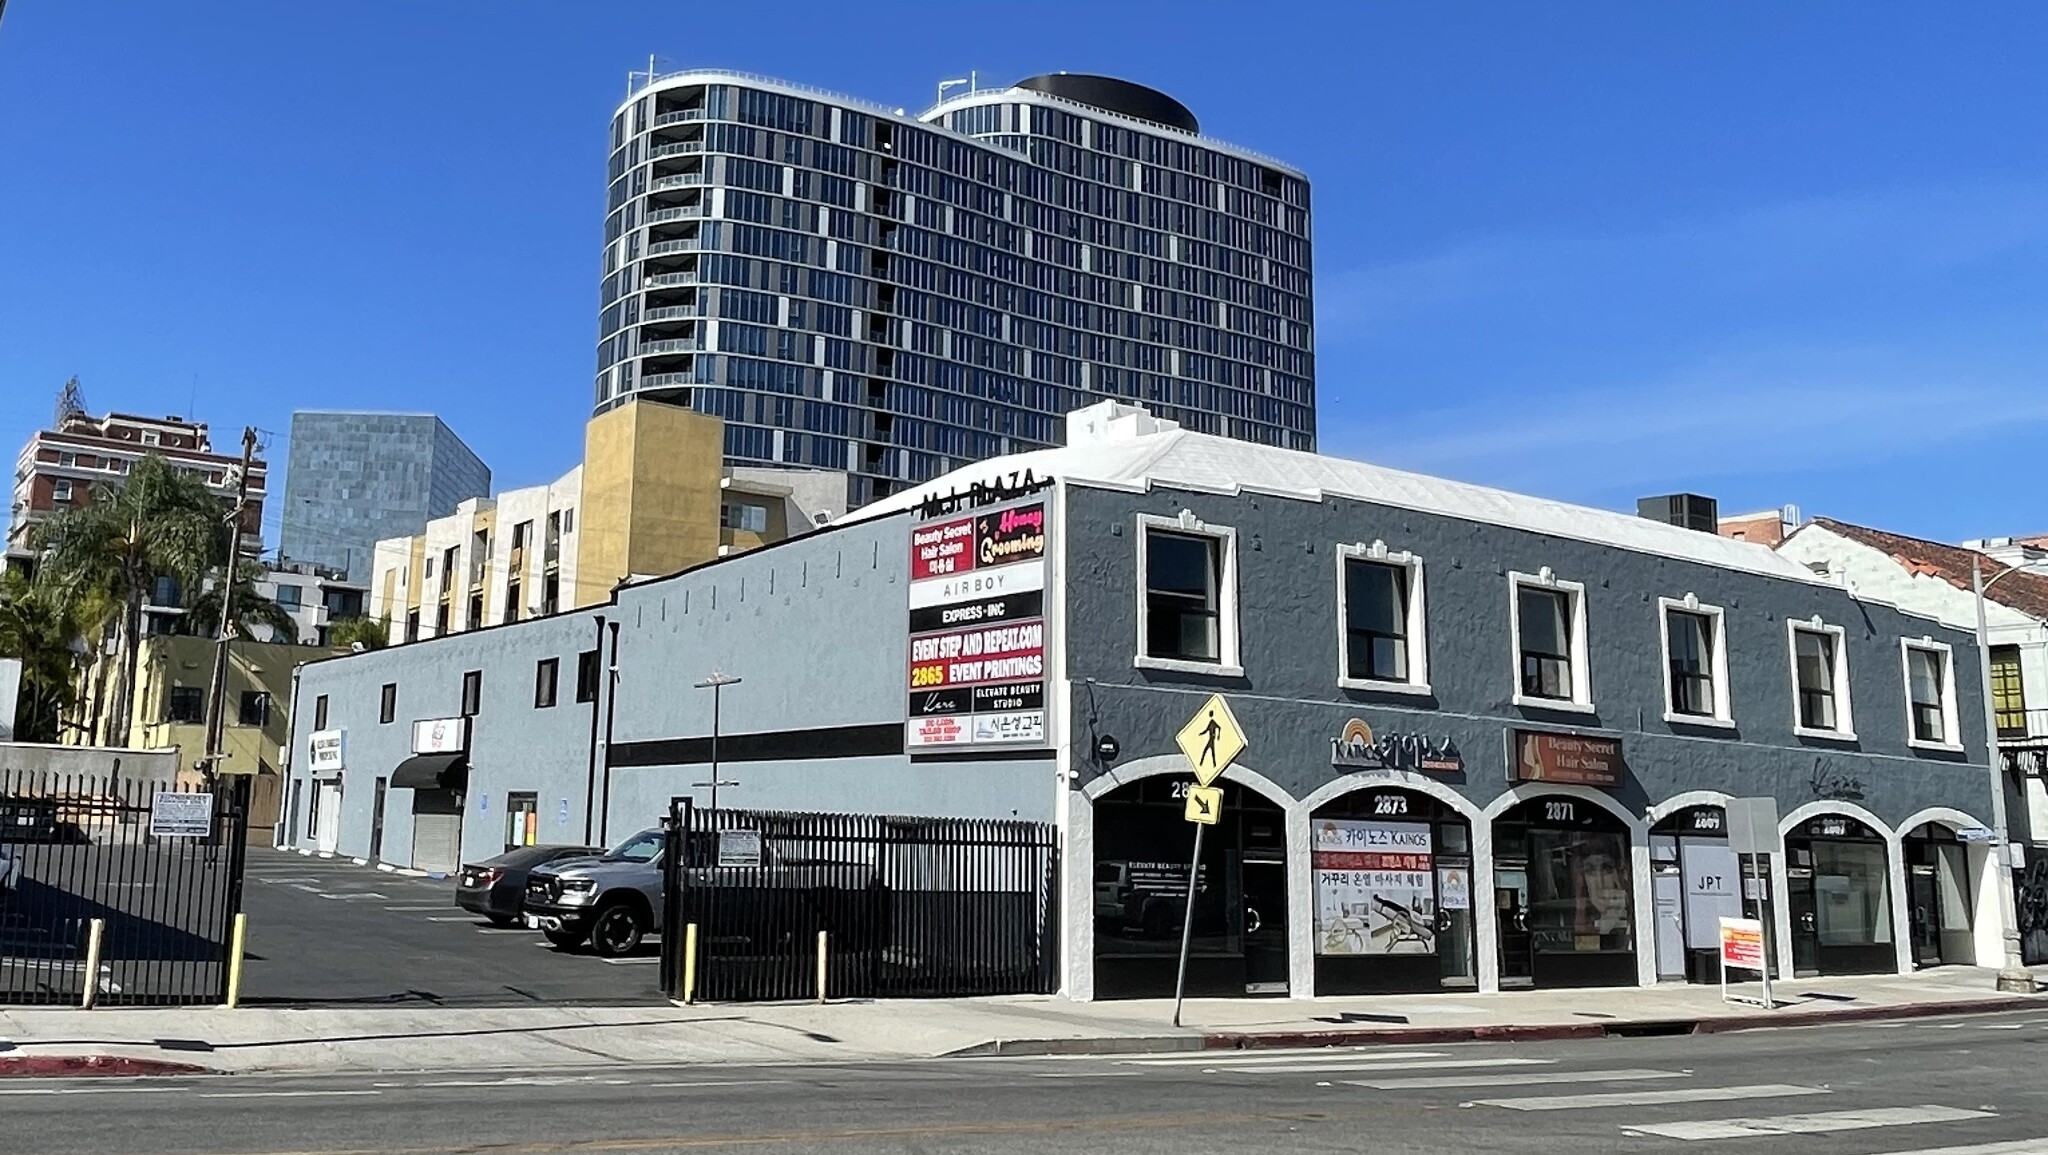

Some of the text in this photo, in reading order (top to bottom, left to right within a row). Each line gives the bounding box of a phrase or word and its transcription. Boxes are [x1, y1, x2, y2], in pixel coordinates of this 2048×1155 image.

[970, 468, 1037, 508] PLAZA
[914, 522, 972, 546] Beauty Secret
[921, 541, 963, 560] Hair Salon
[980, 533, 1044, 563] Grooming
[912, 624, 1043, 662] EVENT STEP AND REPEAT.COM
[912, 655, 1043, 687] 2865 EVENT PRINTINGS
[993, 698, 1023, 709] STUDIO
[1548, 736, 1615, 755] Beauty Secret
[1556, 754, 1609, 771] Hair Salon
[1374, 795, 1408, 815] 2873
[1545, 802, 1574, 821] 2871
[1345, 829, 1388, 847] 카이노스
[1390, 832, 1427, 846] KAINOS
[1321, 872, 1350, 886] 거꾸리
[1698, 876, 1722, 890] JPT
